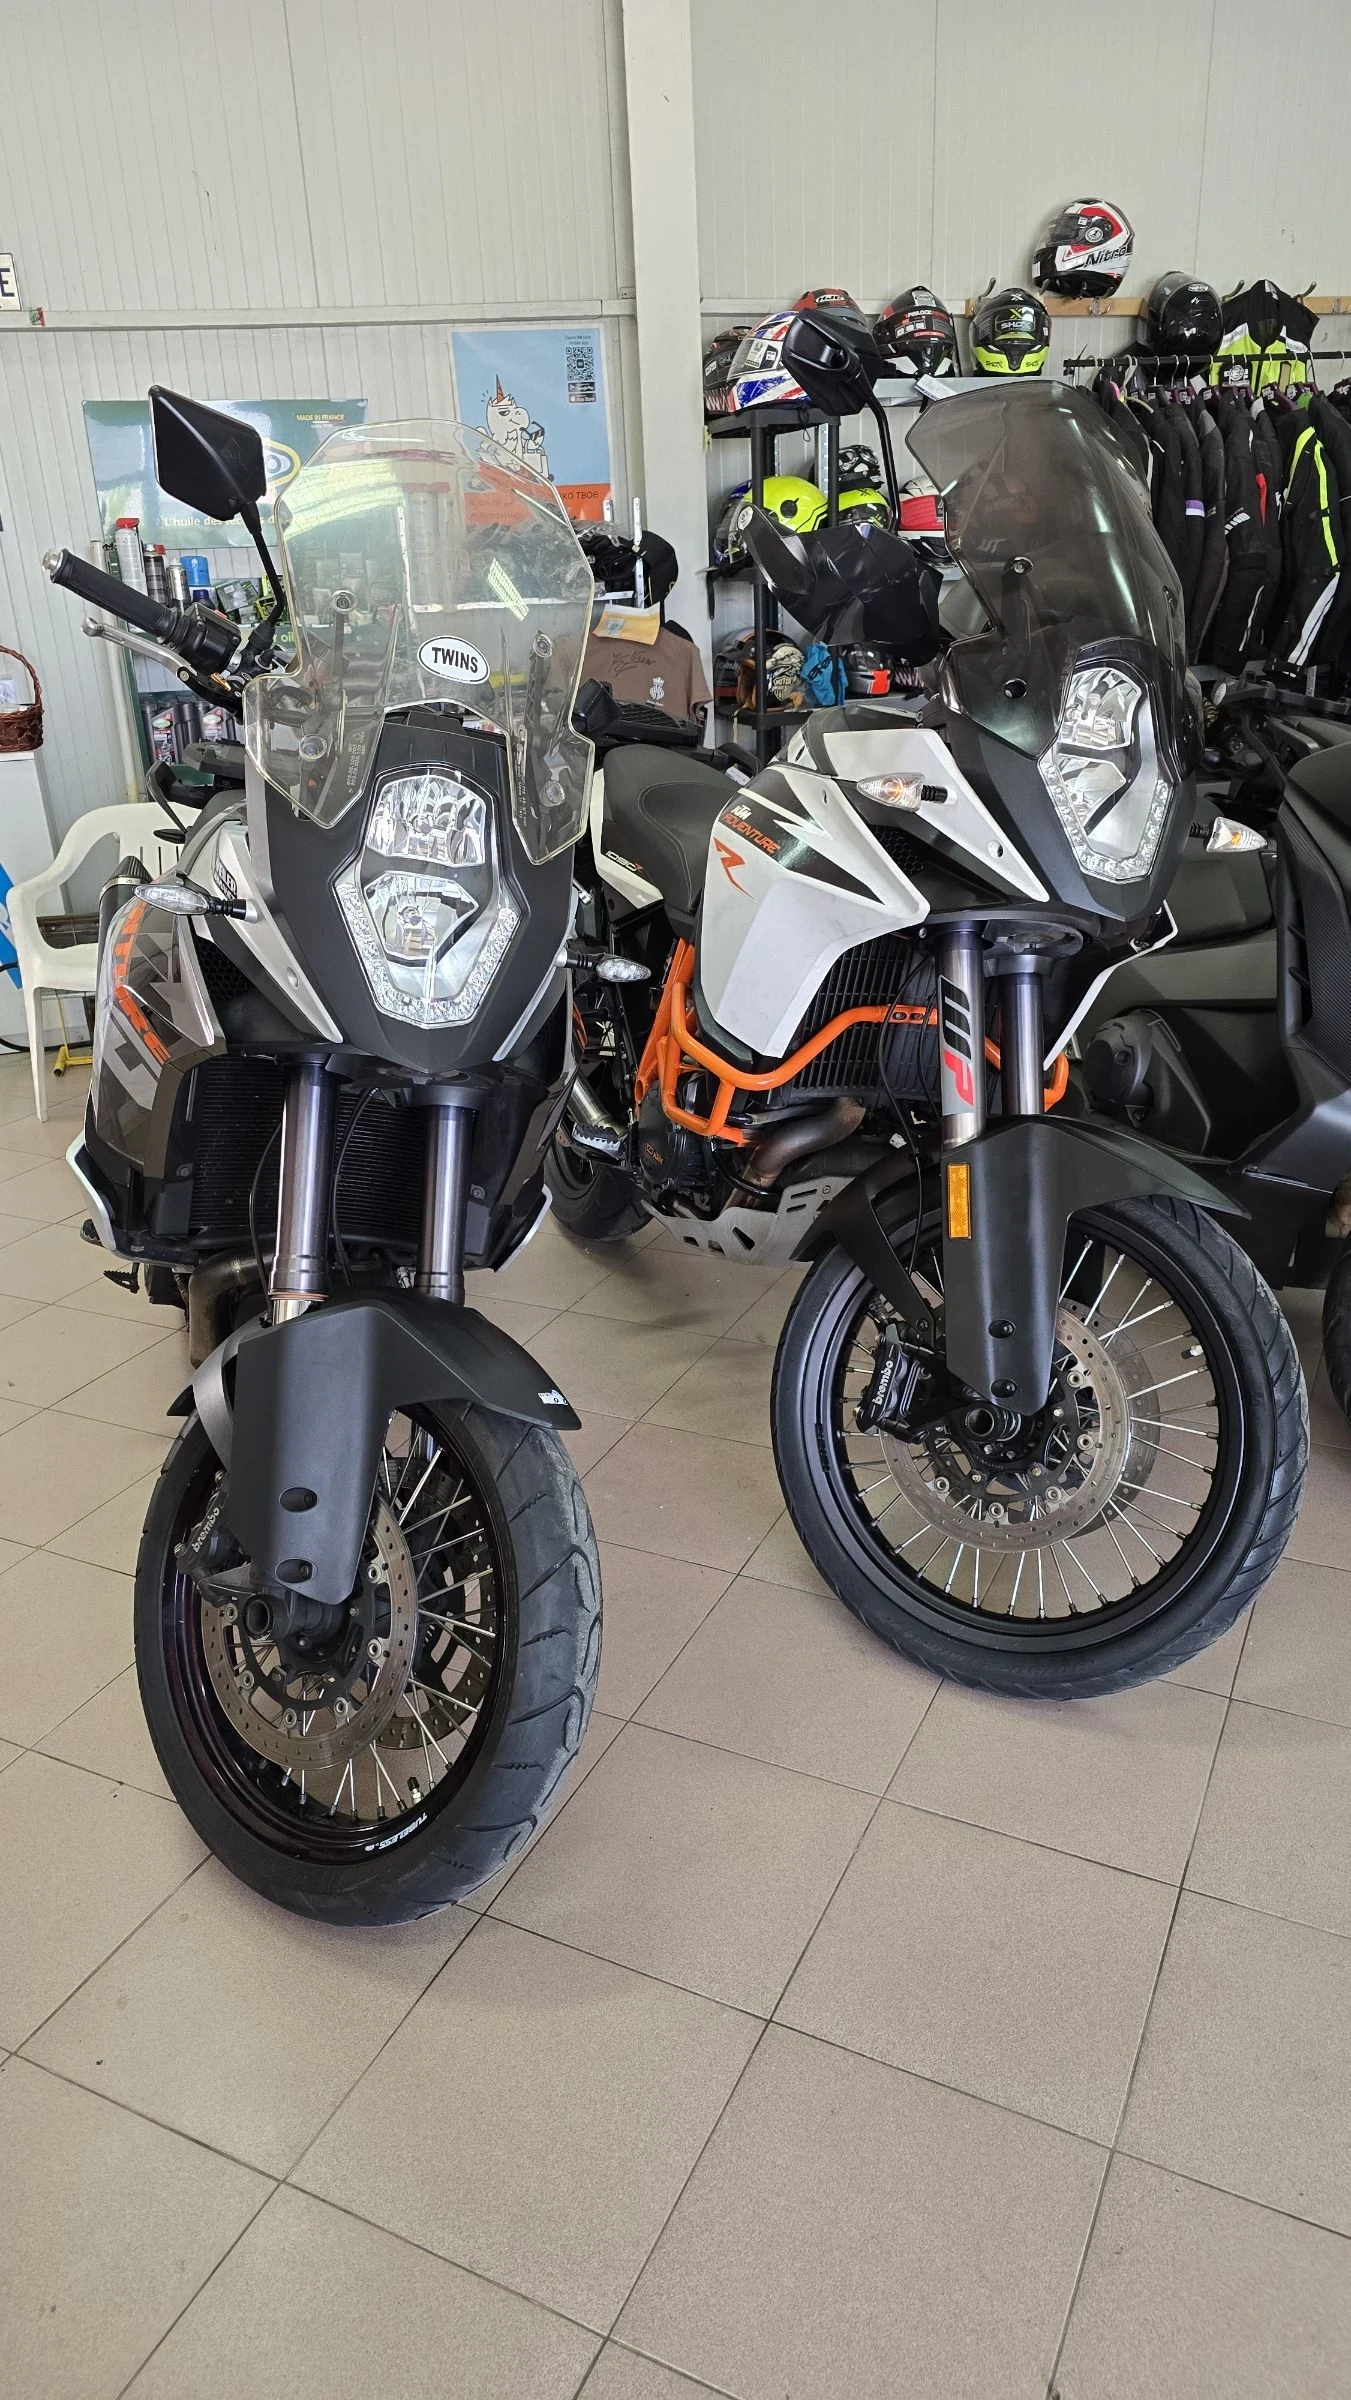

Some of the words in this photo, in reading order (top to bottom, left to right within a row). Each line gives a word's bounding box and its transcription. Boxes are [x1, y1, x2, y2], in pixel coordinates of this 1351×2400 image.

[1084, 246, 1127, 267] Nitro
[164, 517, 200, 527] L'huile
[431, 646, 478, 673] TWINS
[730, 804, 753, 821] KTM
[723, 813, 781, 854] ADVENTURE
[872, 1360, 894, 1405] brembo
[191, 1506, 220, 1553] brembo
